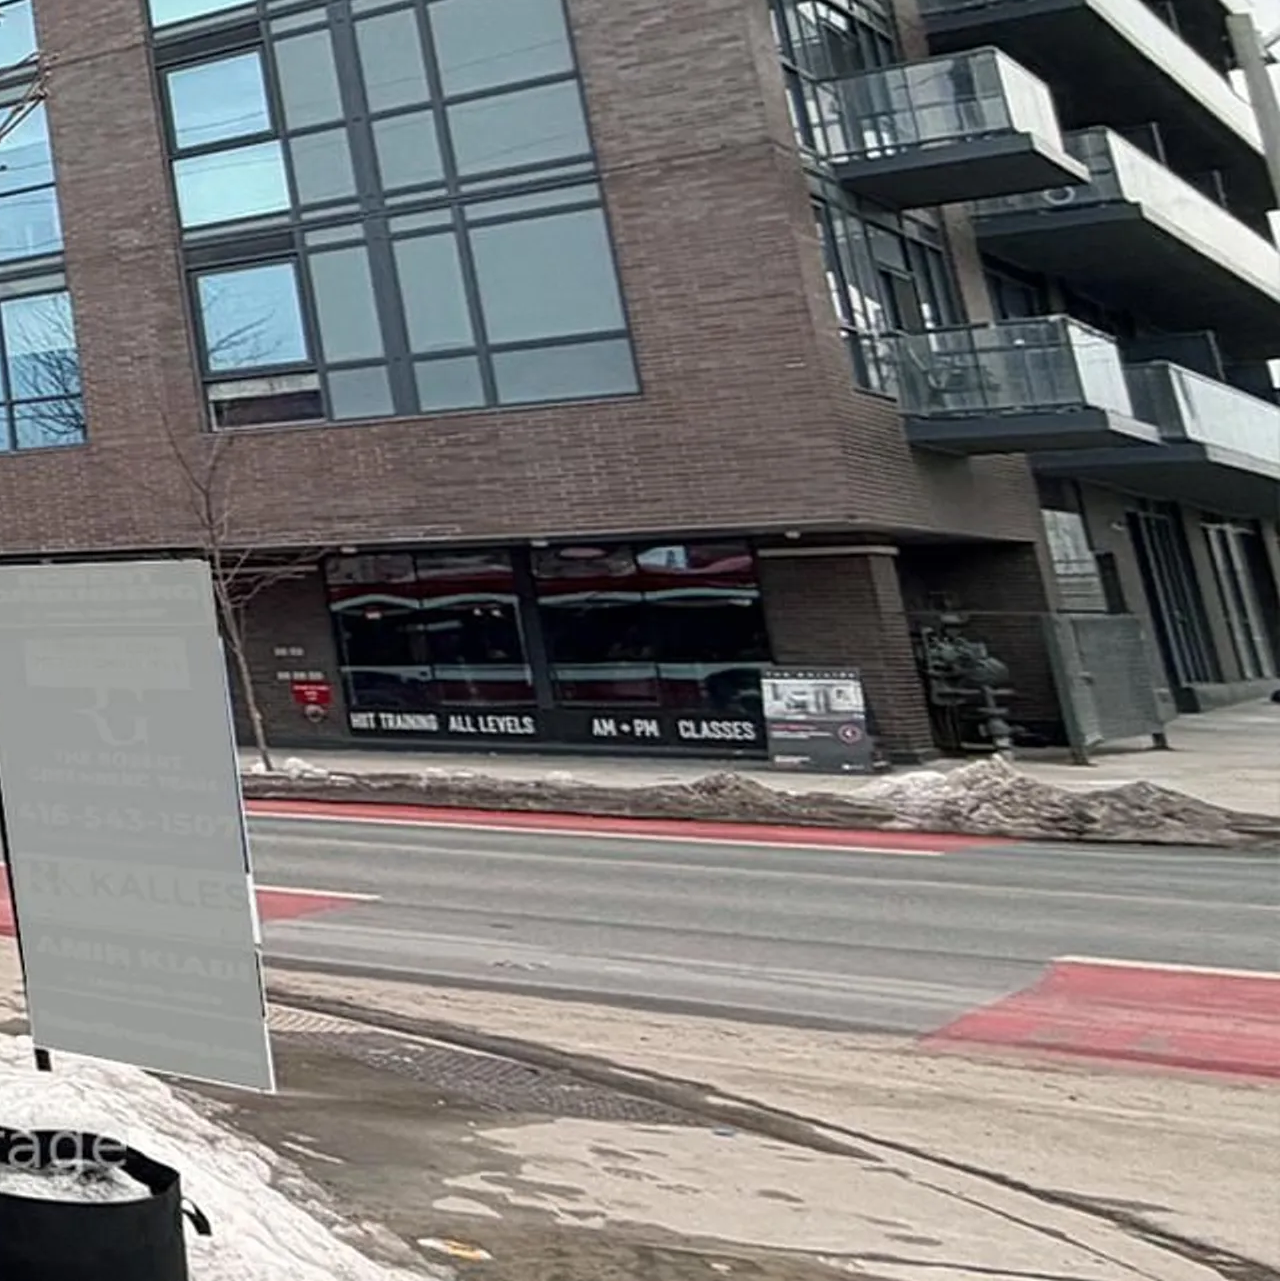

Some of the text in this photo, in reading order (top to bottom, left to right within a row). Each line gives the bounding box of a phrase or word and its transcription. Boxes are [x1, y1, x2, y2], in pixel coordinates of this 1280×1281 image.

[378, 712, 438, 732] TRAINING
[447, 715, 476, 733] ALL
[478, 716, 536, 735] LEVELS
[591, 718, 617, 737] AM
[632, 719, 660, 737] PM
[677, 720, 757, 740] CLASSES
[16, 801, 239, 839] 416-543-1507
[89, 869, 245, 912] KALLES
